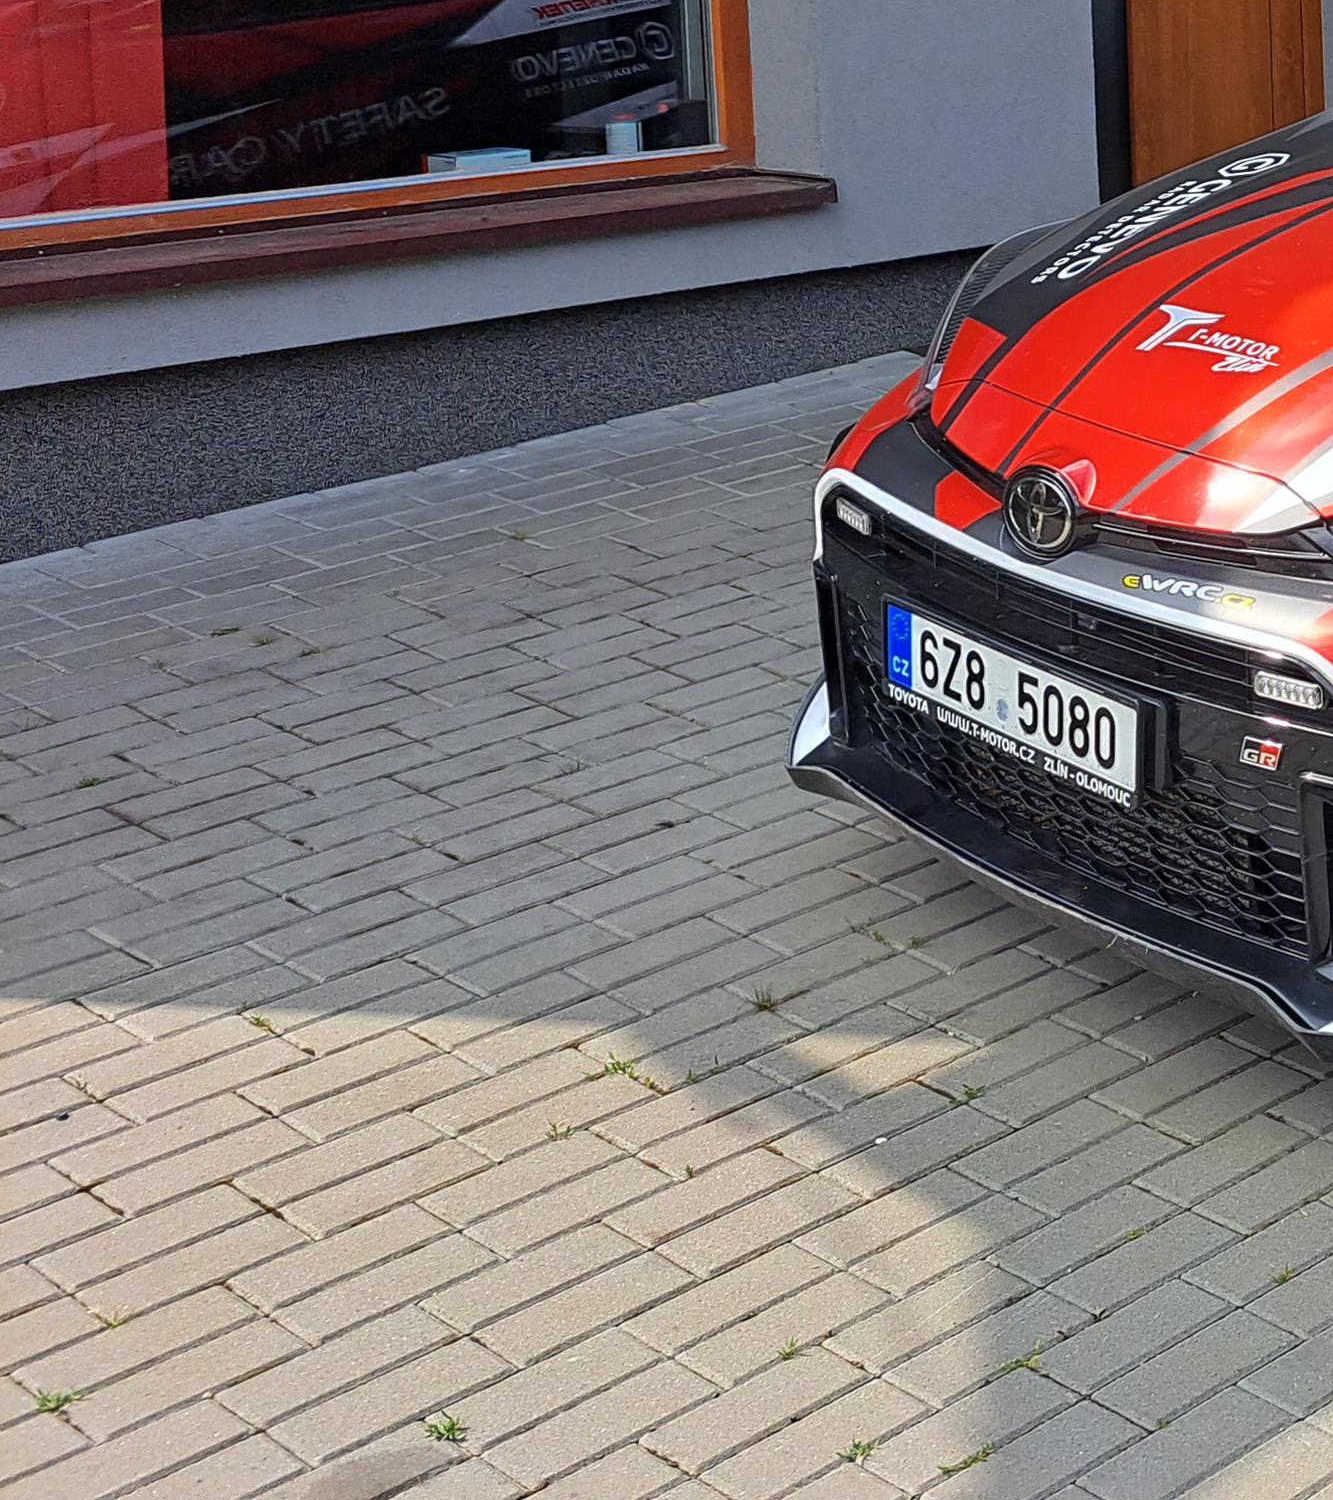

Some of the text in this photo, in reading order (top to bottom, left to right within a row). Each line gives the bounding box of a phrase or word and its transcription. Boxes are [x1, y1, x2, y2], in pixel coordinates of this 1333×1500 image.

[1030, 180, 1198, 284] RADAR DETECTORS
[1057, 178, 1231, 280] GENEVO
[1188, 328, 1280, 361] T-MOTOR
[892, 655, 910, 678] CZ
[920, 629, 1116, 770] 6Z8 5080
[888, 683, 930, 715] TOYOTA
[936, 706, 1036, 764] WWW.T-MOTOR.CZ
[1043, 756, 1068, 780] ZLÍN
[1075, 772, 1131, 808] OLOMOUC
[1242, 744, 1278, 769] GR
